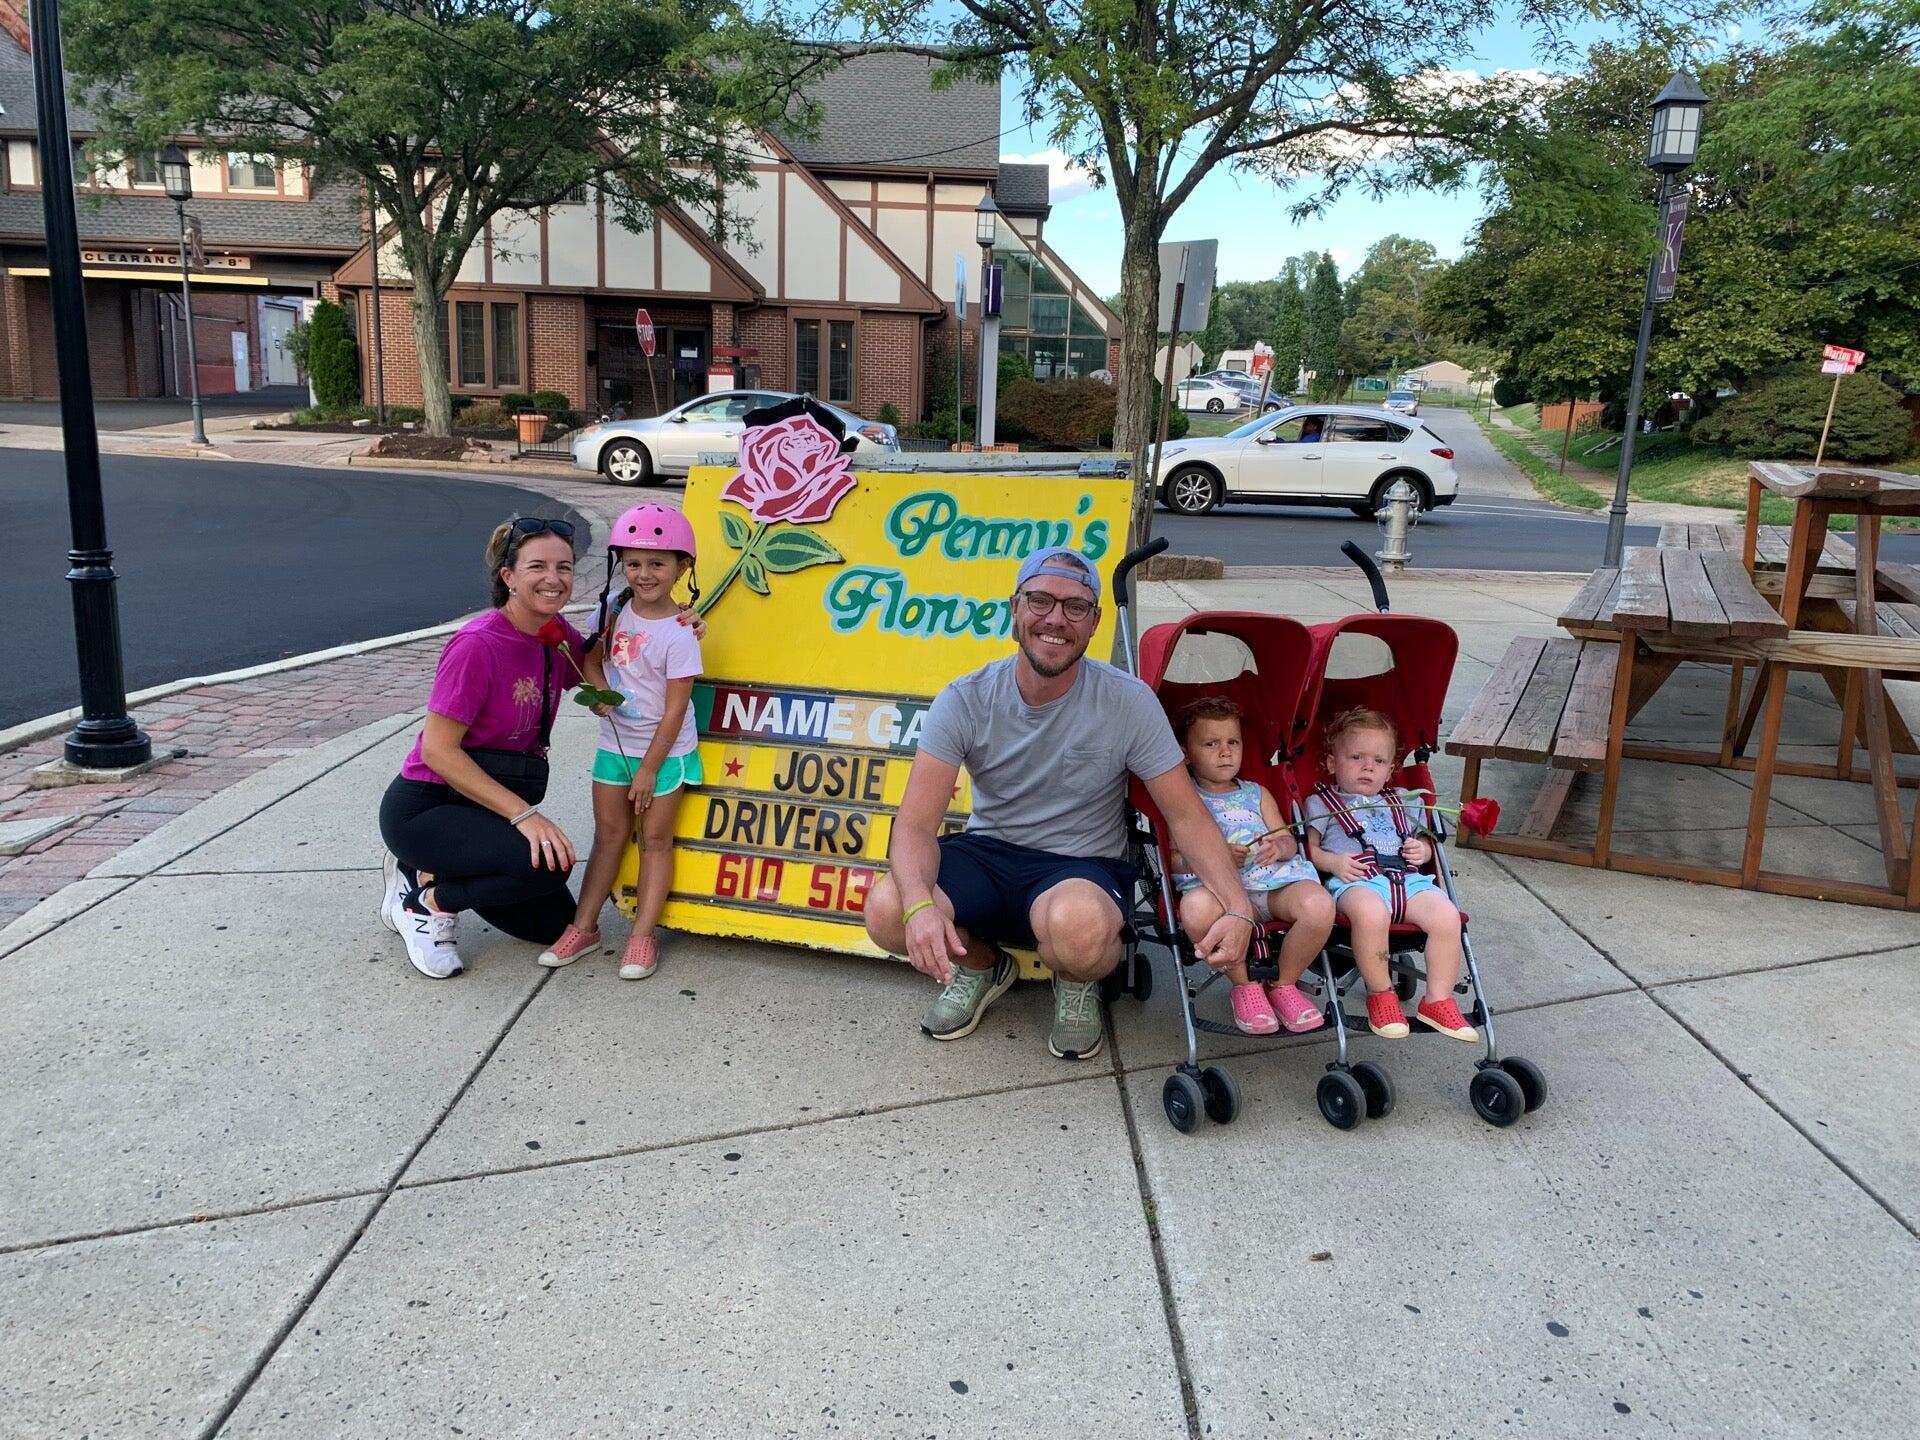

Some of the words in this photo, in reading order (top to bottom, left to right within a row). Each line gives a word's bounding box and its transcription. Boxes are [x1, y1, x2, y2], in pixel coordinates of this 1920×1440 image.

[1661, 220, 1684, 273] K
[637, 324, 654, 341] STOP
[889, 491, 1108, 561] Penny's
[829, 567, 1012, 632] Flower
[721, 693, 856, 740] NAME
[866, 705, 928, 749] GA
[774, 751, 886, 801] JOSIE
[704, 798, 867, 855] DRIVERS
[715, 853, 784, 903] 610
[808, 864, 875, 914] 513
